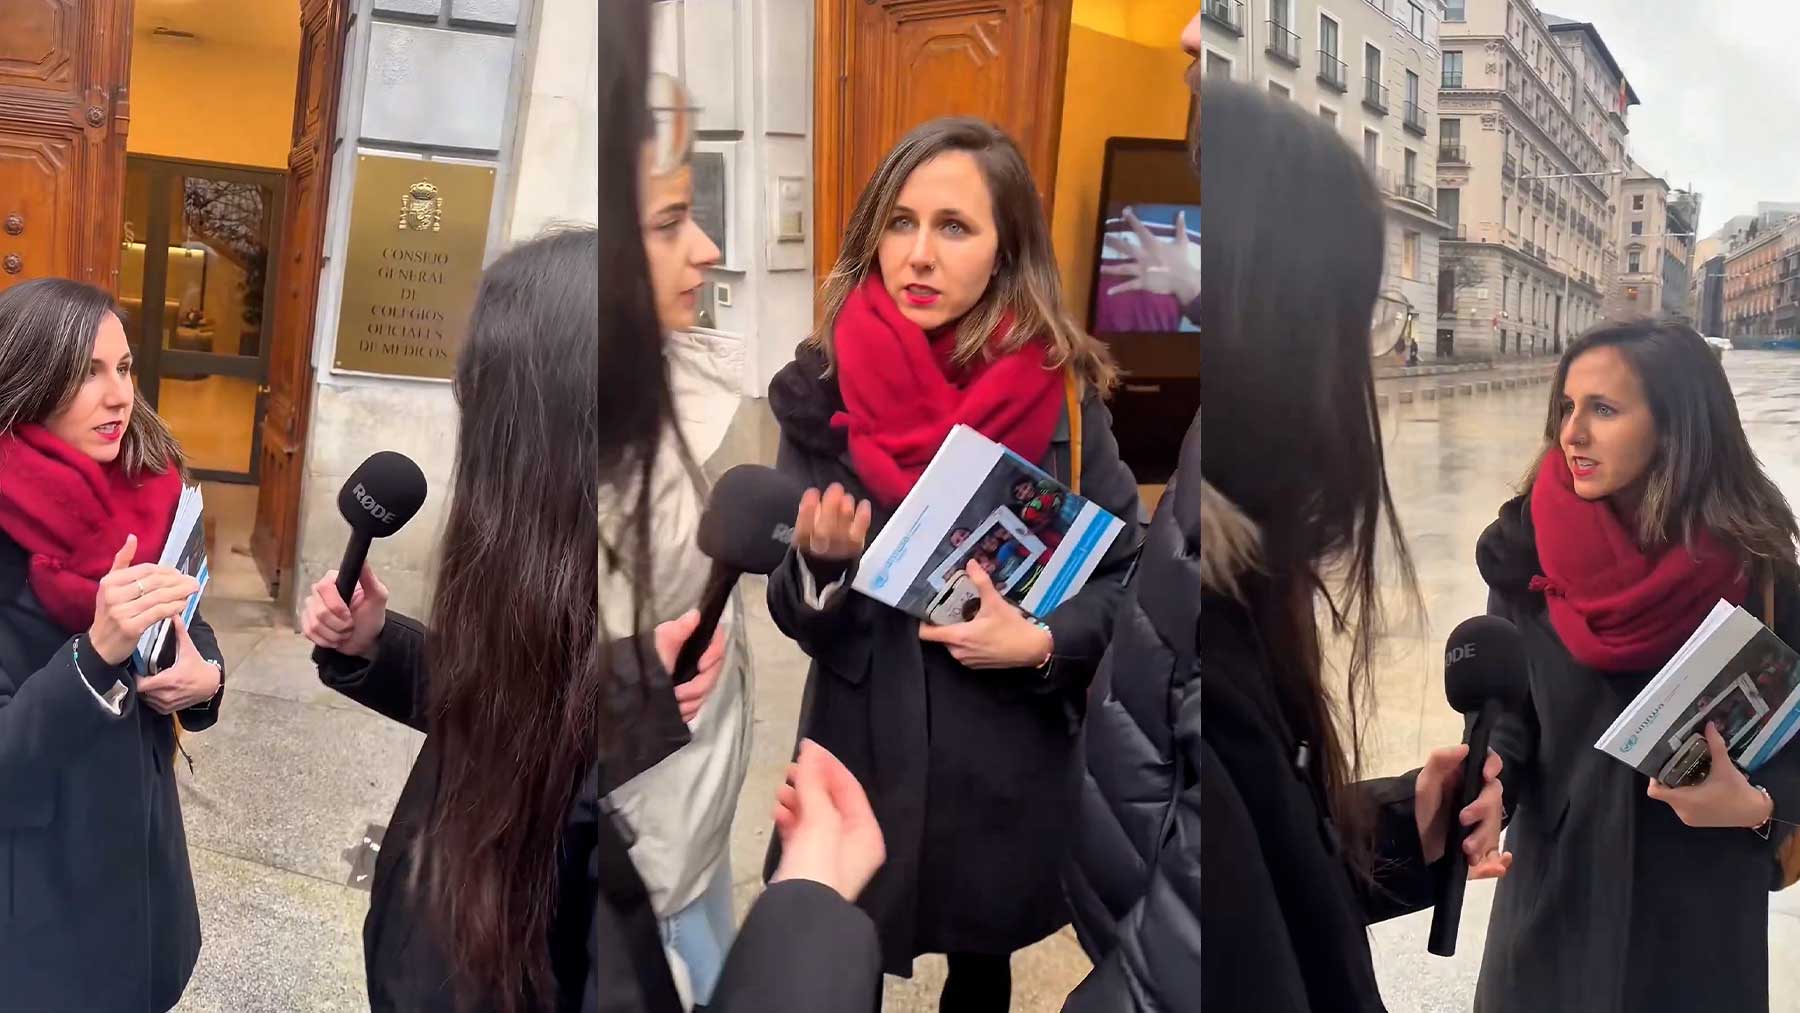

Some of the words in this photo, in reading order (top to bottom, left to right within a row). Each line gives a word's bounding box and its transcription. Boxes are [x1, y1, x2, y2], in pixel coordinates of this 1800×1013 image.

[382, 247, 448, 264] CONSEJO
[378, 267, 444, 285] GENERAL
[401, 288, 416, 301] DE
[371, 304, 445, 321] COLEGIOS
[367, 323, 443, 340] OFICIALES
[360, 340, 377, 353] DE
